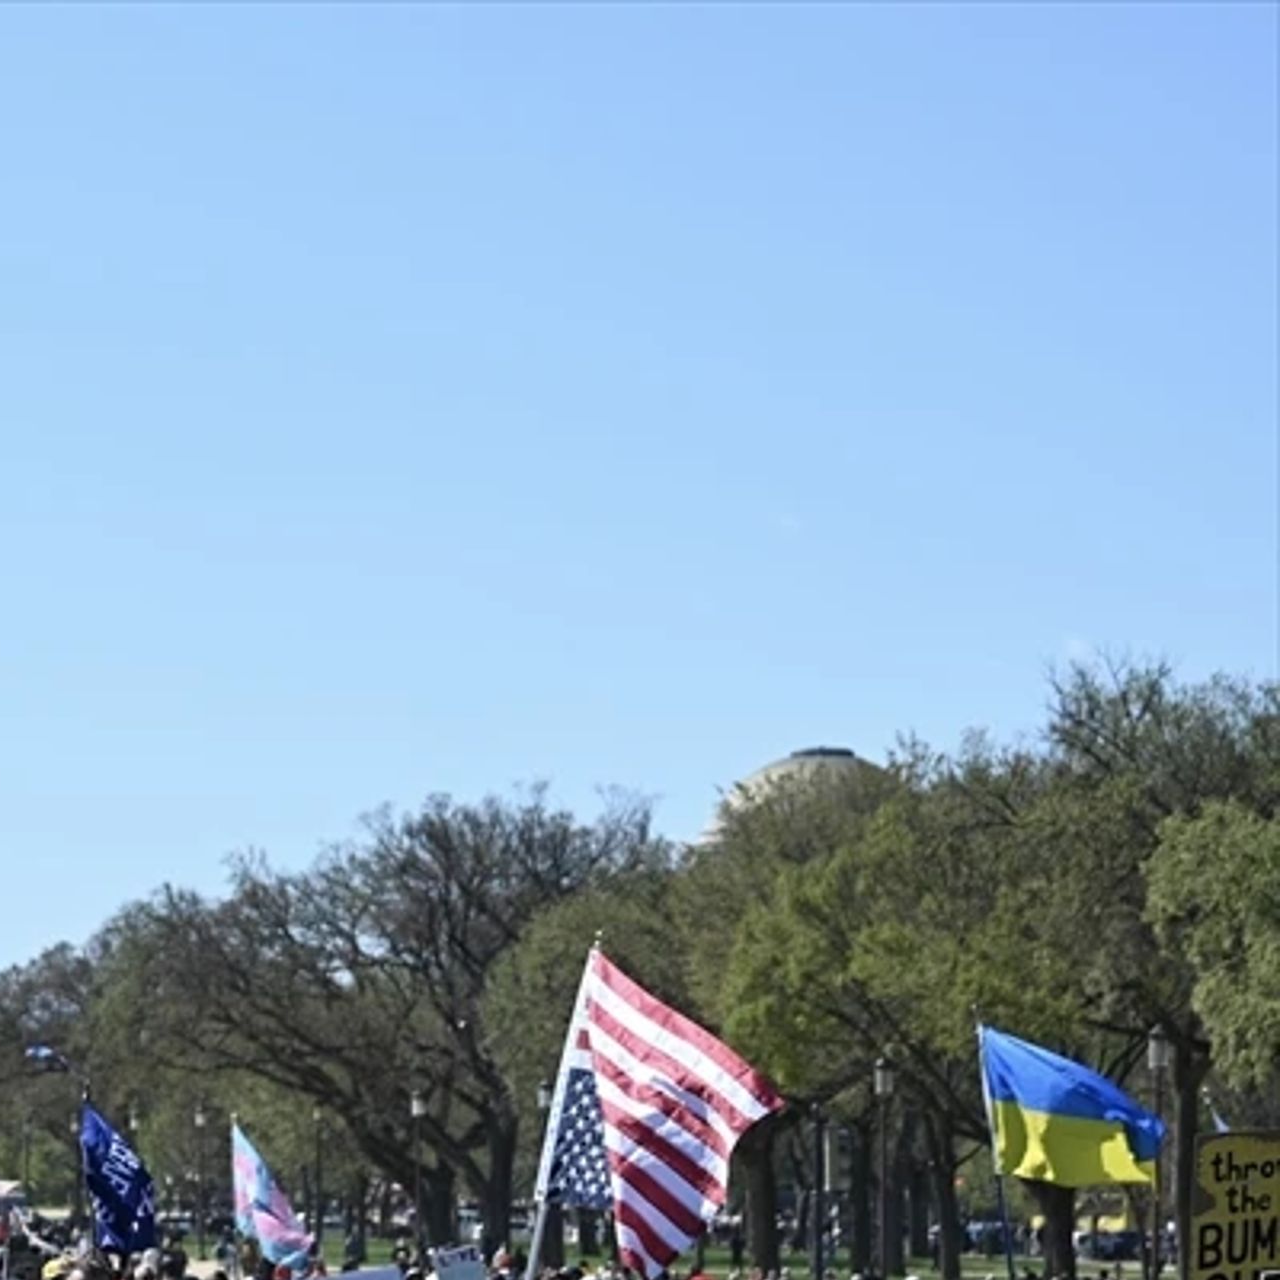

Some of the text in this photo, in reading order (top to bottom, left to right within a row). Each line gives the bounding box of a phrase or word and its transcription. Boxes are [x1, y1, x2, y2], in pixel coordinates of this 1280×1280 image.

[1211, 1151, 1280, 1182] thro
[1225, 1184, 1271, 1213] the
[1198, 1216, 1280, 1270] BUM
